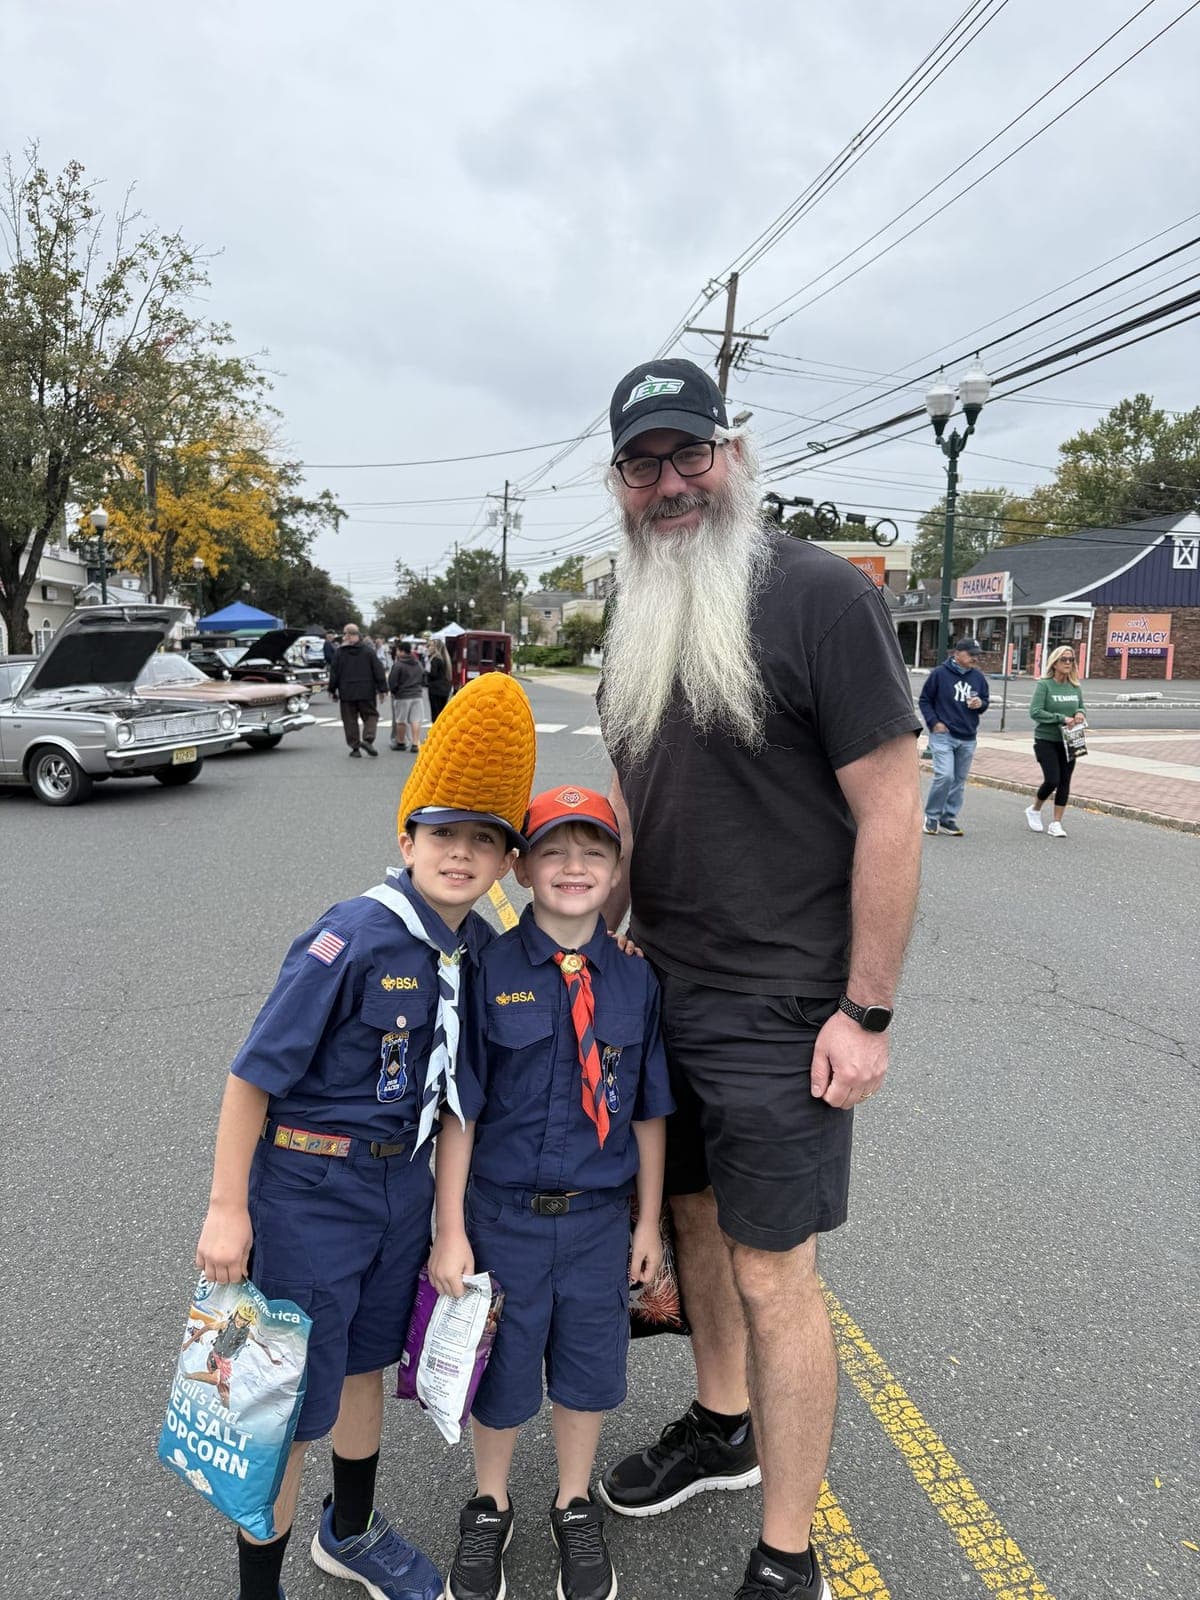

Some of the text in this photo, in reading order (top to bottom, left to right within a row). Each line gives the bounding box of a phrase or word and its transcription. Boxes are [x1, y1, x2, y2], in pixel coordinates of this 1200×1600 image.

[622, 375, 685, 412] JETS
[963, 575, 1003, 595] PHARMACY
[1111, 631, 1168, 643] PHARMACY
[395, 977, 419, 990] BSA
[511, 991, 536, 1003] BSA
[171, 1378, 191, 1422] EA
[194, 1410, 253, 1452] SALT
[207, 1396, 240, 1425] End
[166, 1408, 250, 1480] OPCORN
